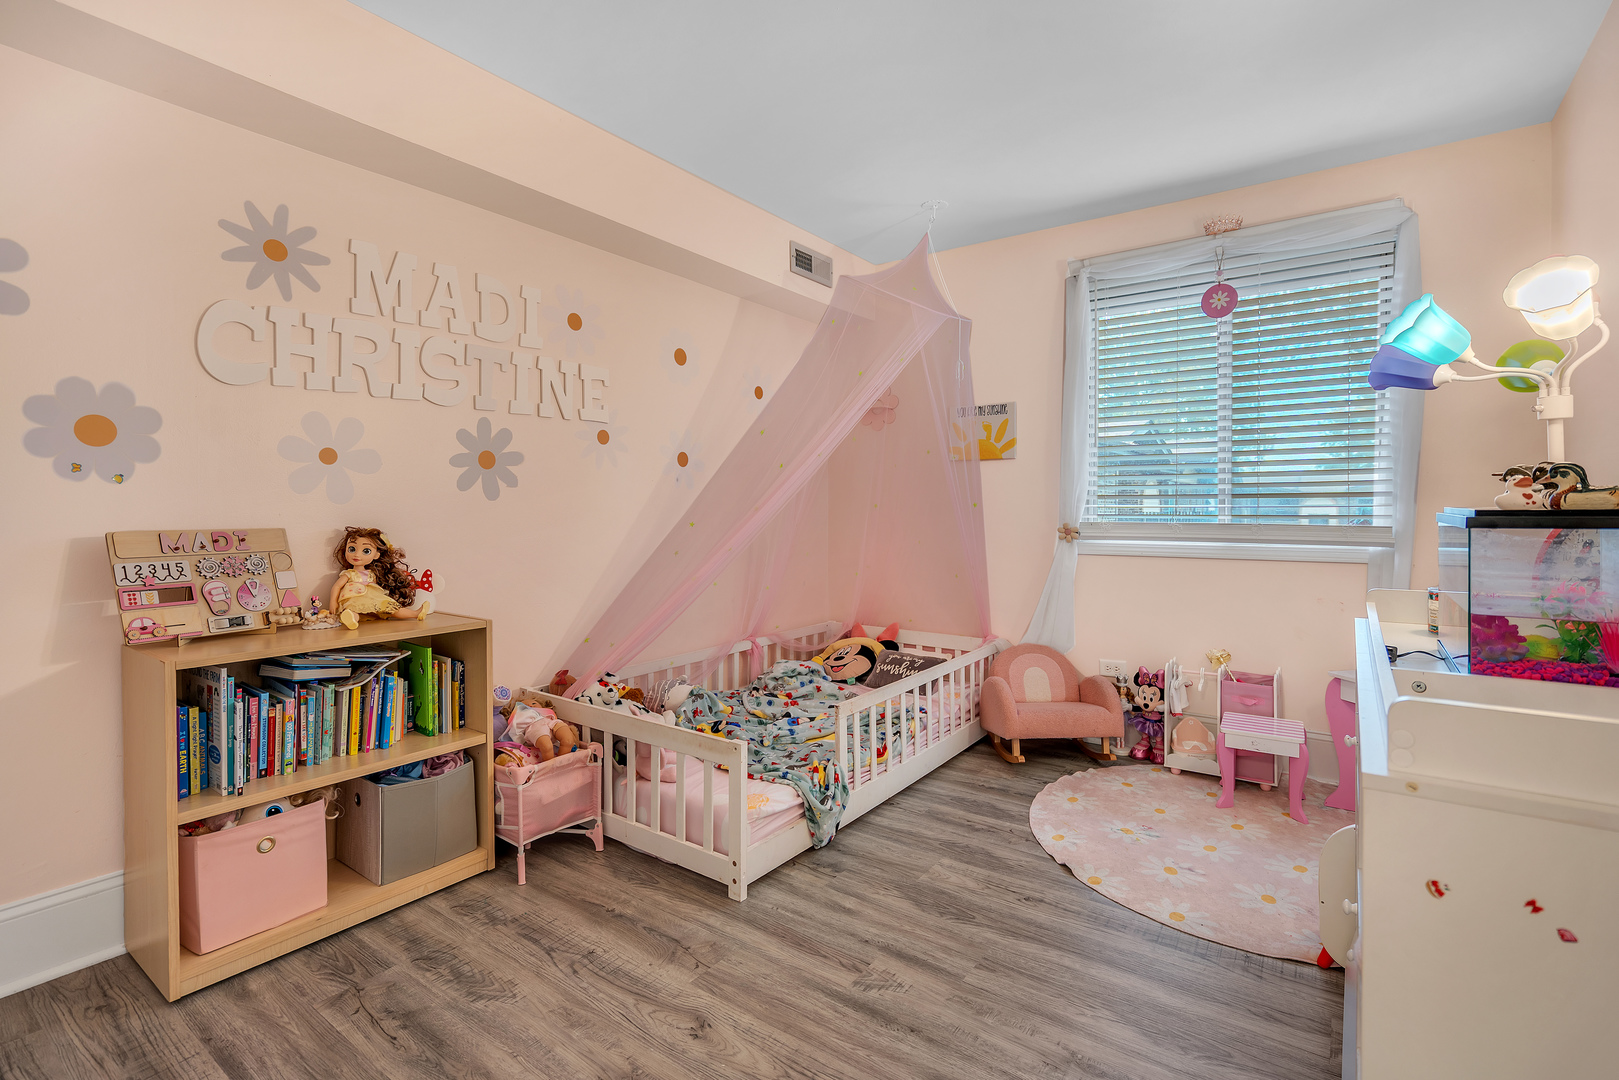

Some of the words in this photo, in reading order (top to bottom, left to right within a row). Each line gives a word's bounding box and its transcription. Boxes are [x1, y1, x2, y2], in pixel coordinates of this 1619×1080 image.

[349, 238, 544, 349] MADI
[195, 298, 610, 424] CHRISTINE
[158, 530, 252, 554] MADI
[876, 661, 919, 678] sunshin
[886, 654, 901, 663] you
[913, 657, 925, 668] my
[179, 750, 187, 774] EARTH
